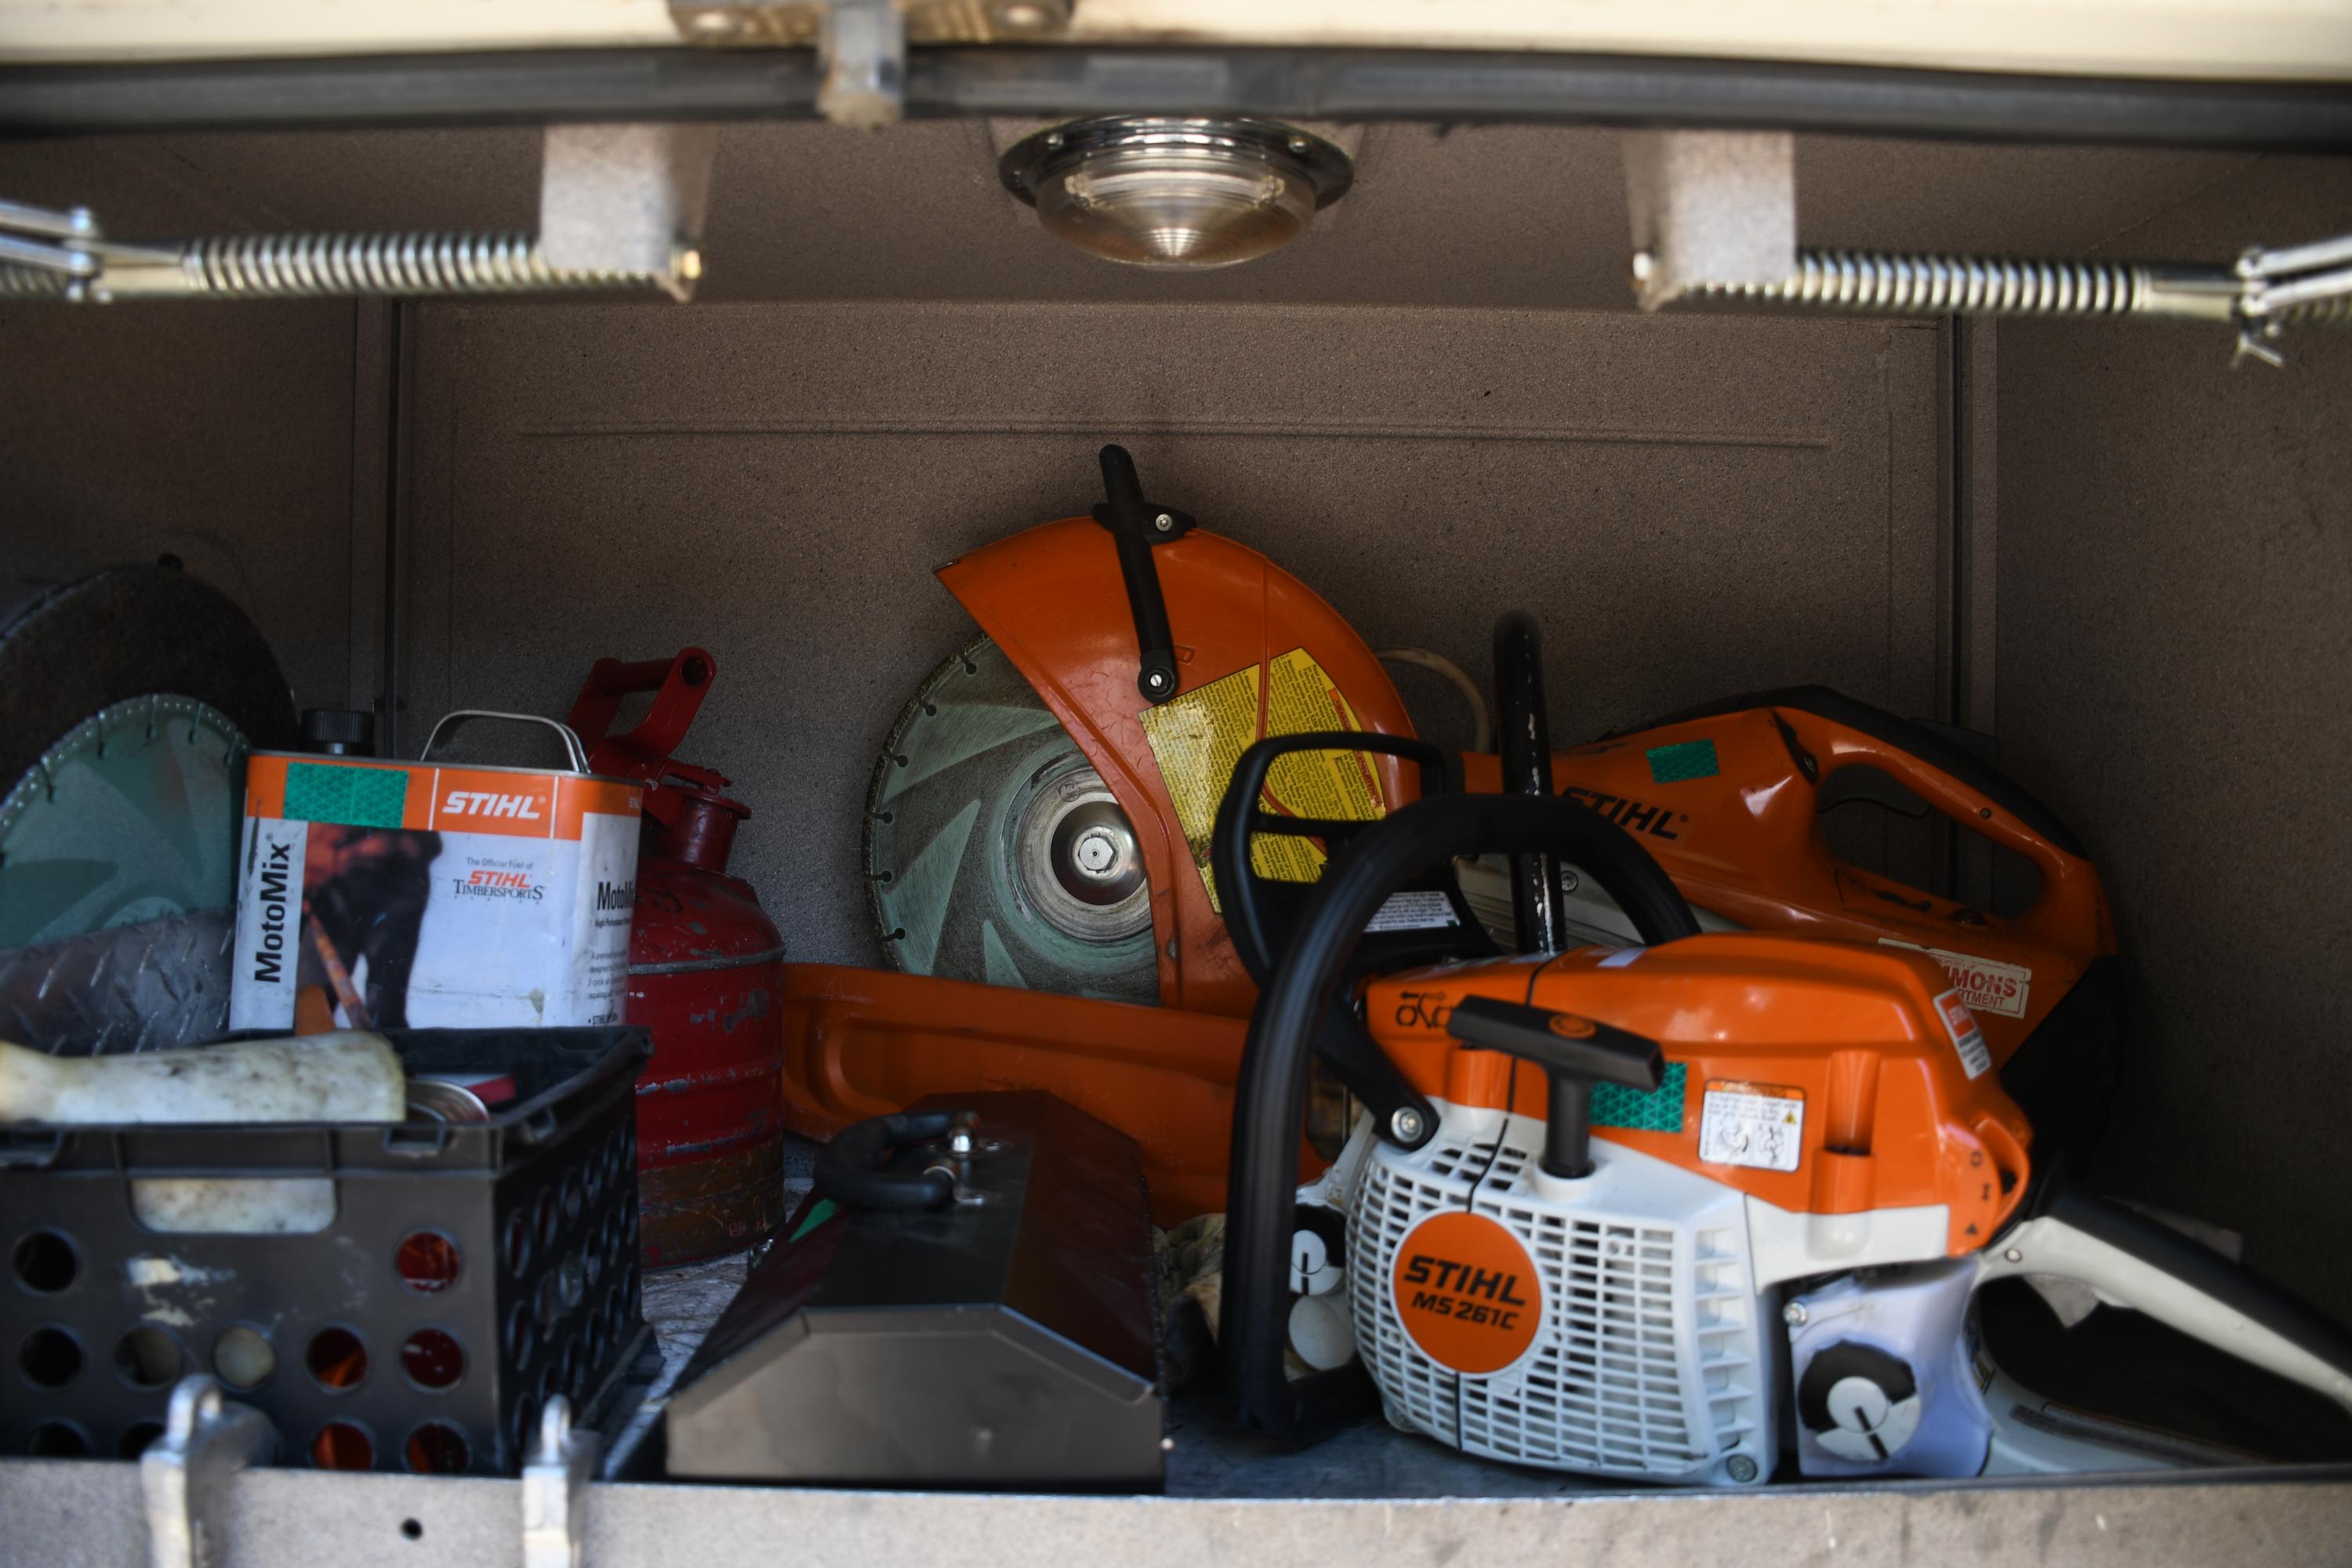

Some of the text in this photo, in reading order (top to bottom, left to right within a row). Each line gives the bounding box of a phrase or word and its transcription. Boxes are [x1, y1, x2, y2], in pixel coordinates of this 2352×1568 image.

[442, 791, 541, 820] STIHL
[468, 869, 531, 888] STIHL
[255, 843, 291, 983] MotoMix
[1960, 989, 2005, 1008] RTMENT
[1403, 1255, 1526, 1306] STIHL
[1412, 1292, 1519, 1330] MS 261C
